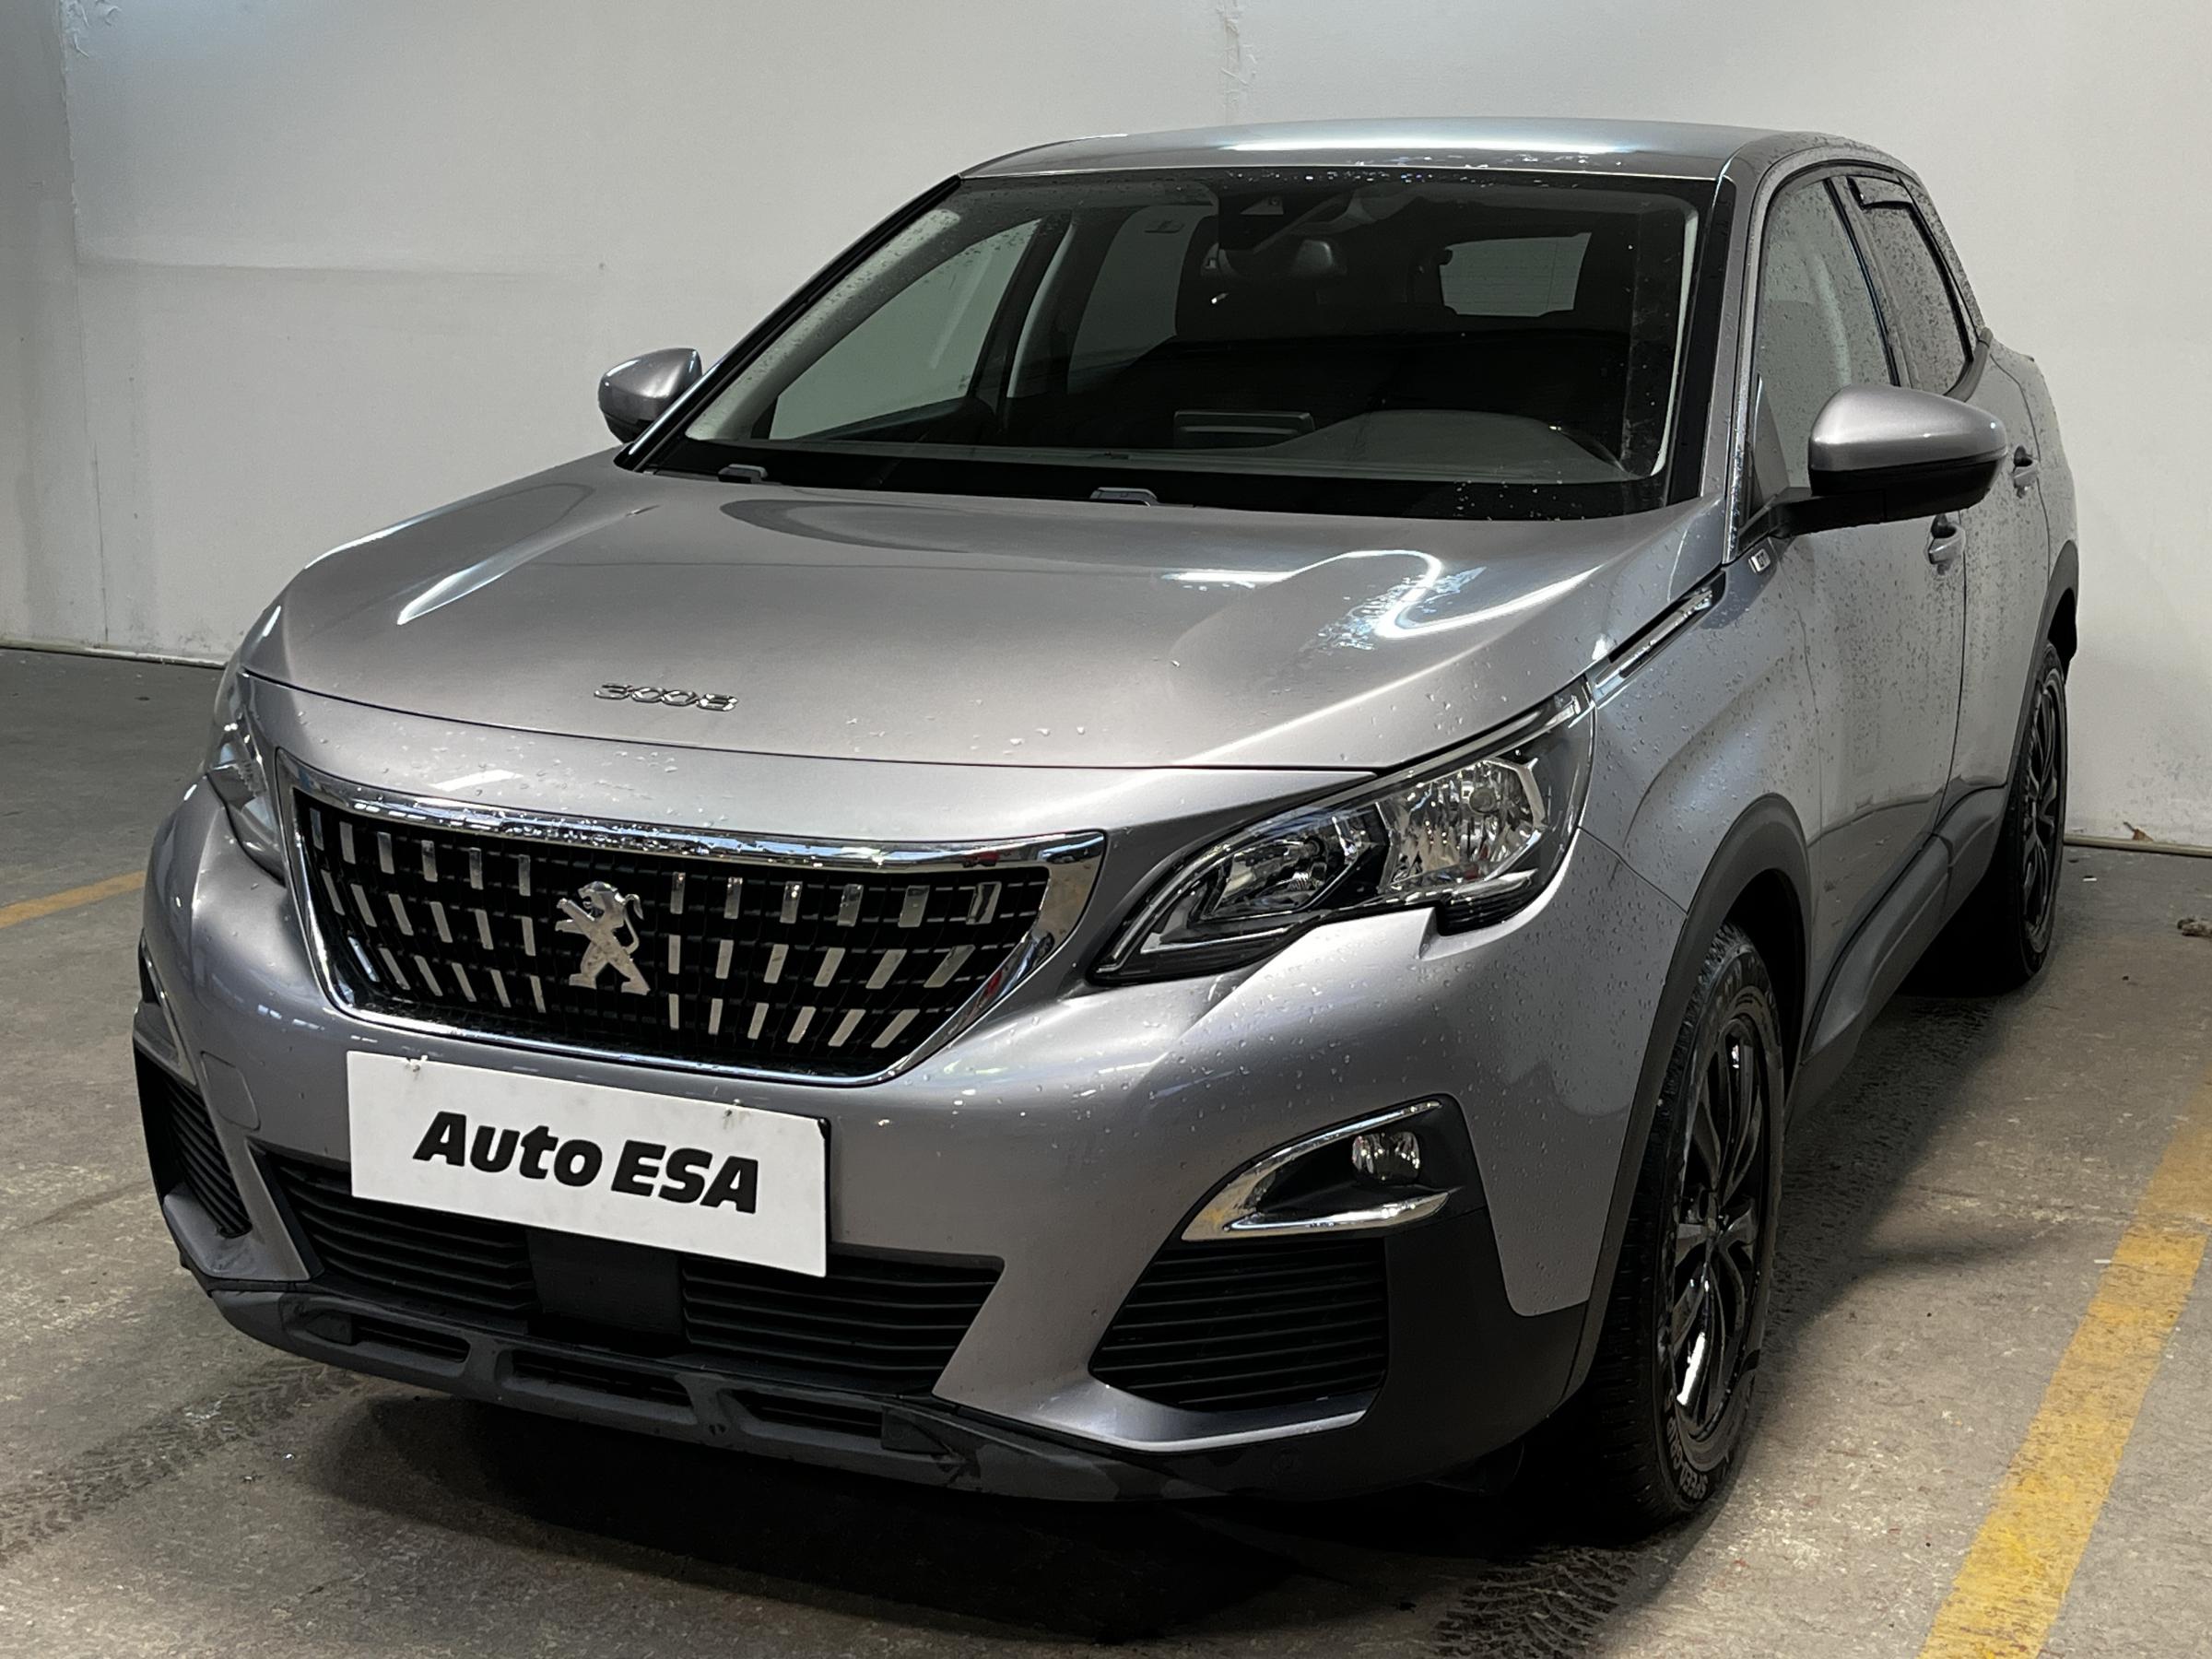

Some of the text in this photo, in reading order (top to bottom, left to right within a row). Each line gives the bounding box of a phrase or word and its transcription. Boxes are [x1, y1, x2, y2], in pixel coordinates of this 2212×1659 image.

[594, 683, 739, 712] 3008
[412, 1111, 759, 1214] Auto ESA
